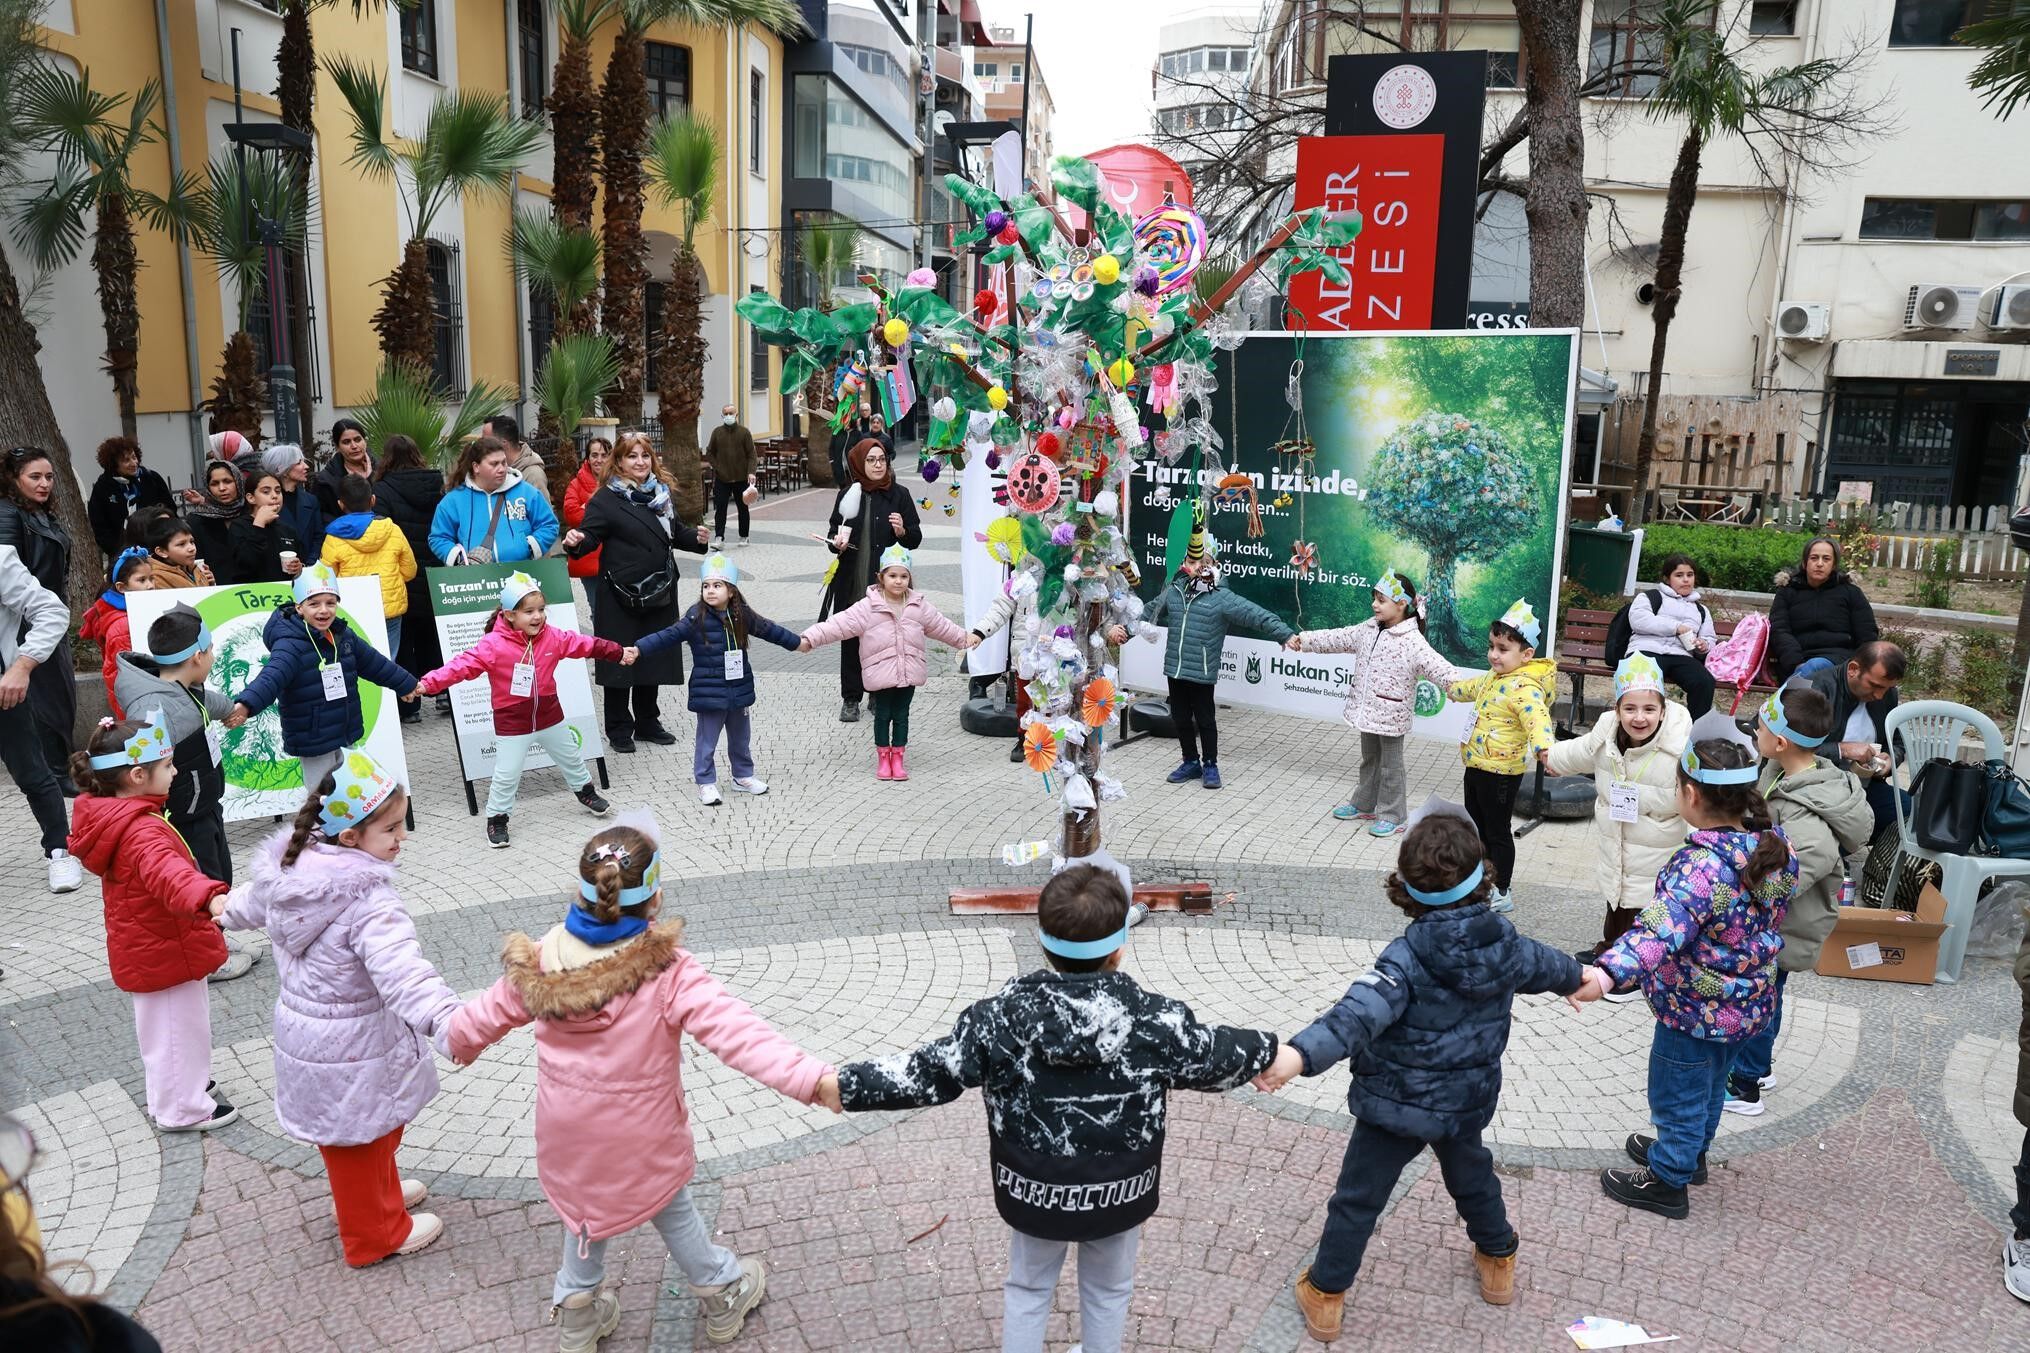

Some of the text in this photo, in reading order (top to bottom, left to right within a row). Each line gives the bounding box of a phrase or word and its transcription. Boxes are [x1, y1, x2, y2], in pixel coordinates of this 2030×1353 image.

[1467, 312, 1530, 329] ress
[1271, 466, 1368, 501] izinde,
[1236, 540, 1273, 559] katkı,
[438, 579, 499, 594] Tarzan'ın
[1319, 568, 1339, 584] bir
[1342, 573, 1371, 588] söz.
[441, 594, 462, 606] doğa
[463, 593, 476, 604] için
[1271, 657, 1330, 682] Hakan
[1284, 682, 1323, 696] Şehzadeler
[996, 1162, 1157, 1211] PERFECTION
